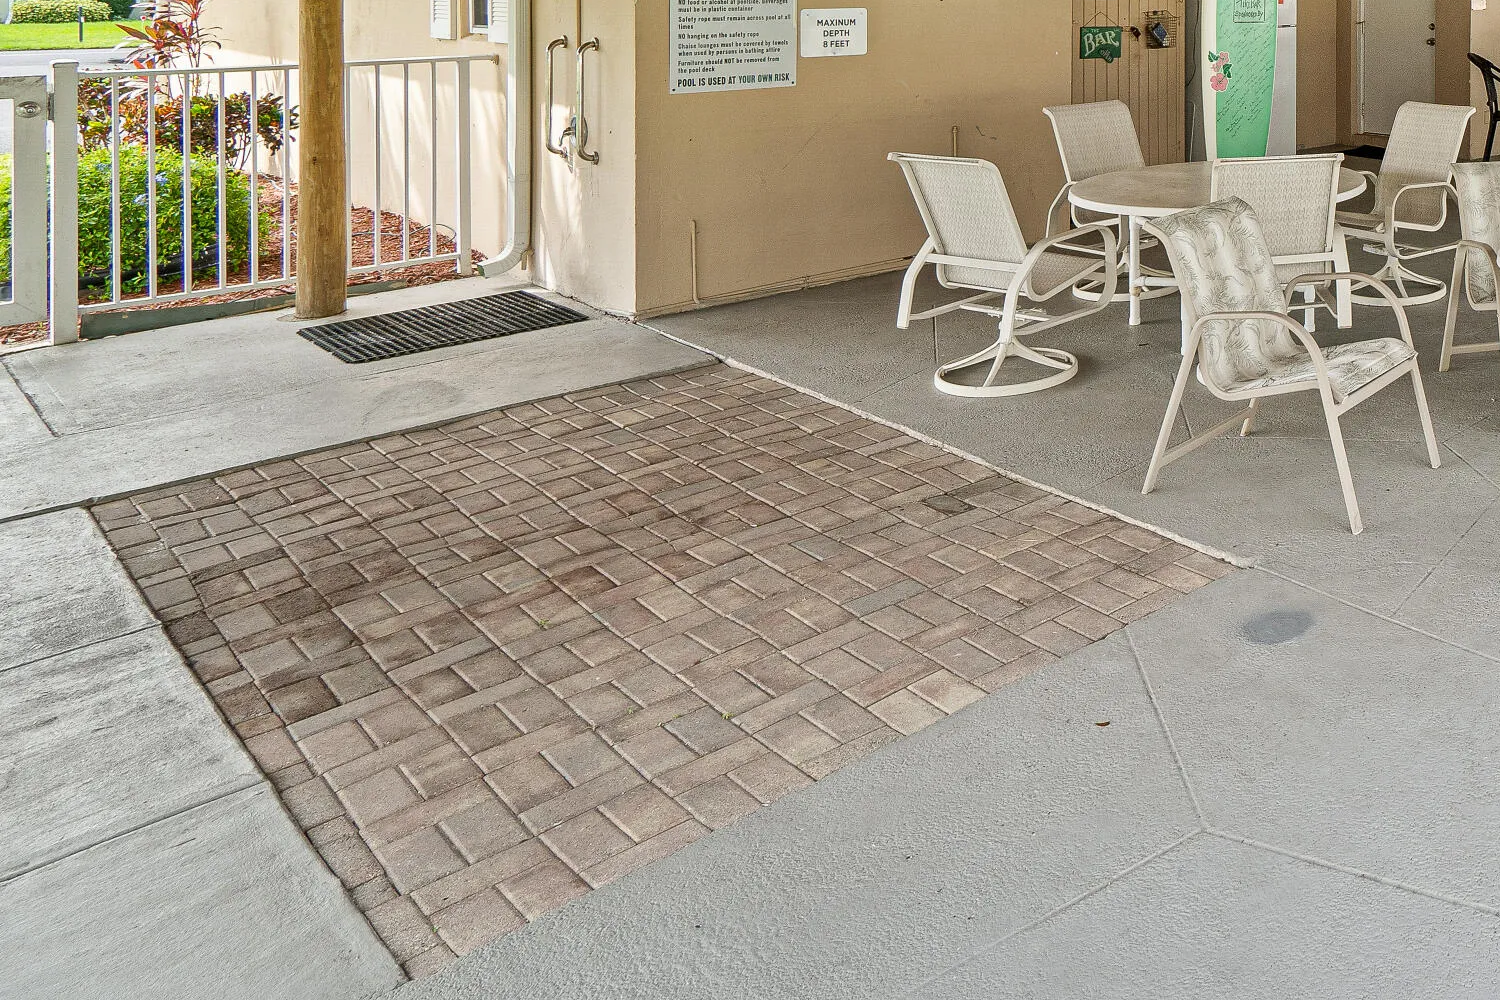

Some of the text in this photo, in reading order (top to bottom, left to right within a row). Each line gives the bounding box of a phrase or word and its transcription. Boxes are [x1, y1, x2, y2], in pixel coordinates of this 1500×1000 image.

[823, 29, 850, 37] DEPTH
[1083, 30, 1119, 56] BAR
[678, 73, 789, 87] POOL IS USED AT YOUR OWN RISK
